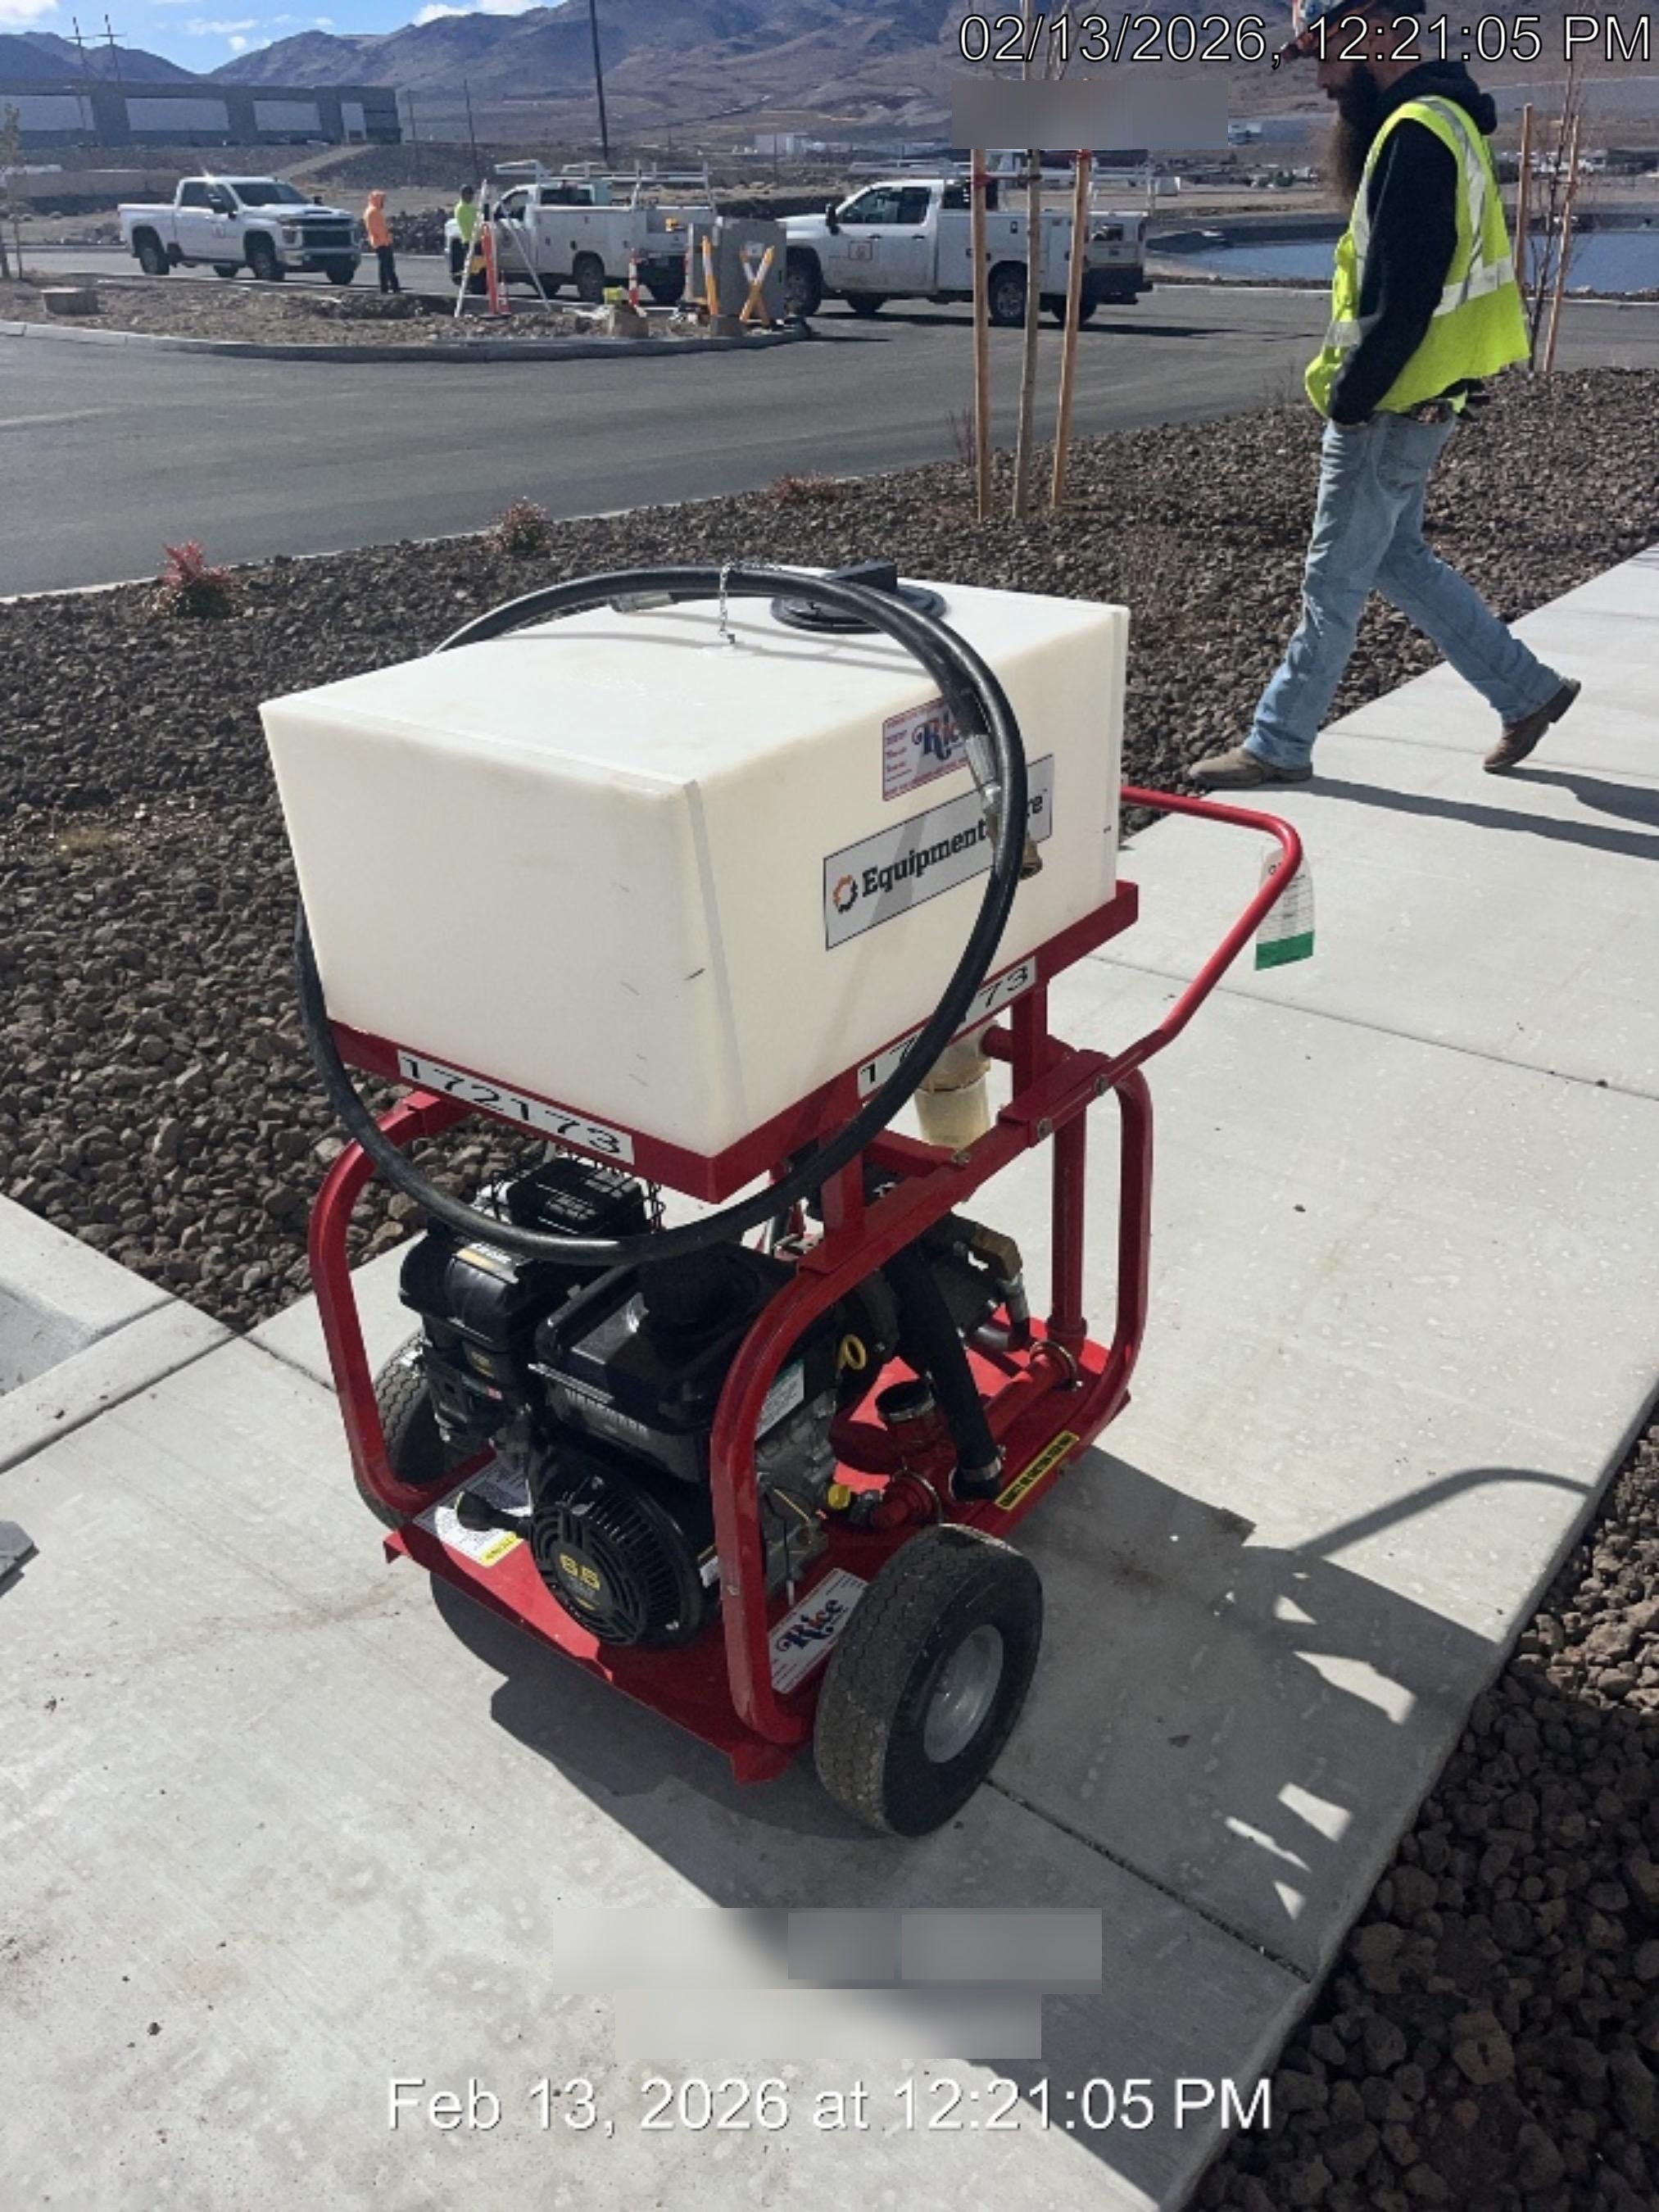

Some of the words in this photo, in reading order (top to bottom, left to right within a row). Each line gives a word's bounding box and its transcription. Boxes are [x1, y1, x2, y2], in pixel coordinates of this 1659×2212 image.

[862, 794, 1043, 899] Equipmente
[860, 966, 1028, 1084] 1773
[402, 1056, 620, 1154] 172173
[776, 1598, 844, 1652] Rice
